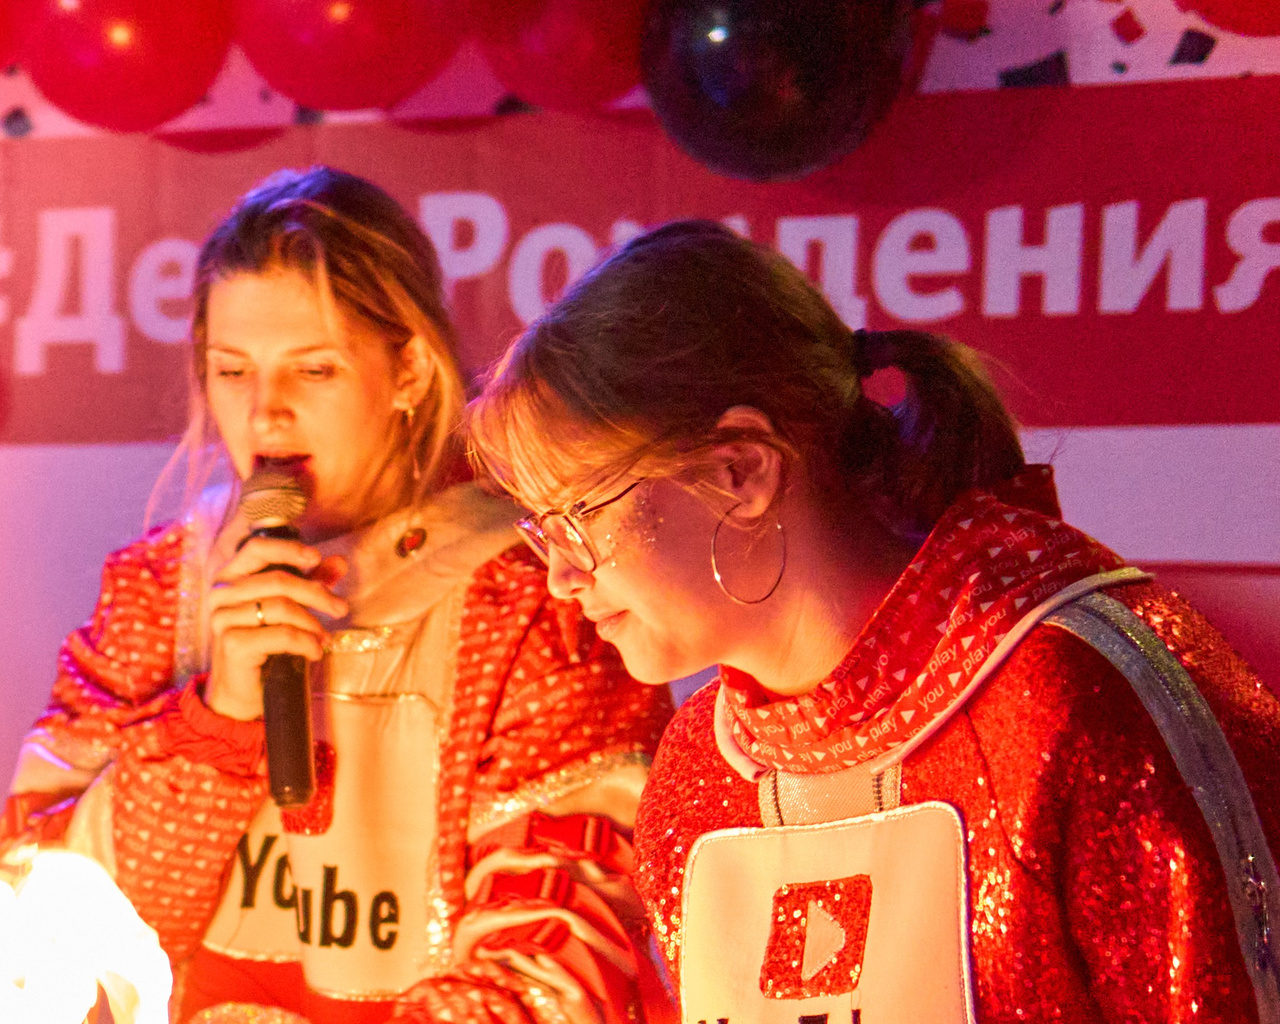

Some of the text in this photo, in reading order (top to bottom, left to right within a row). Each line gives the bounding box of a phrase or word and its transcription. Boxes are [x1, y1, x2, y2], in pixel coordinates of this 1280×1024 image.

[1004, 525, 1036, 548] play
[963, 583, 992, 604] you
[928, 644, 958, 676] play
[980, 607, 1007, 636] you
[946, 608, 974, 636] play
[790, 721, 810, 739] you
[826, 690, 855, 718] play
[828, 740, 853, 758] you
[869, 717, 898, 741] play
[918, 684, 945, 712] you
[962, 642, 991, 675] play
[237, 833, 400, 950] Yoube
